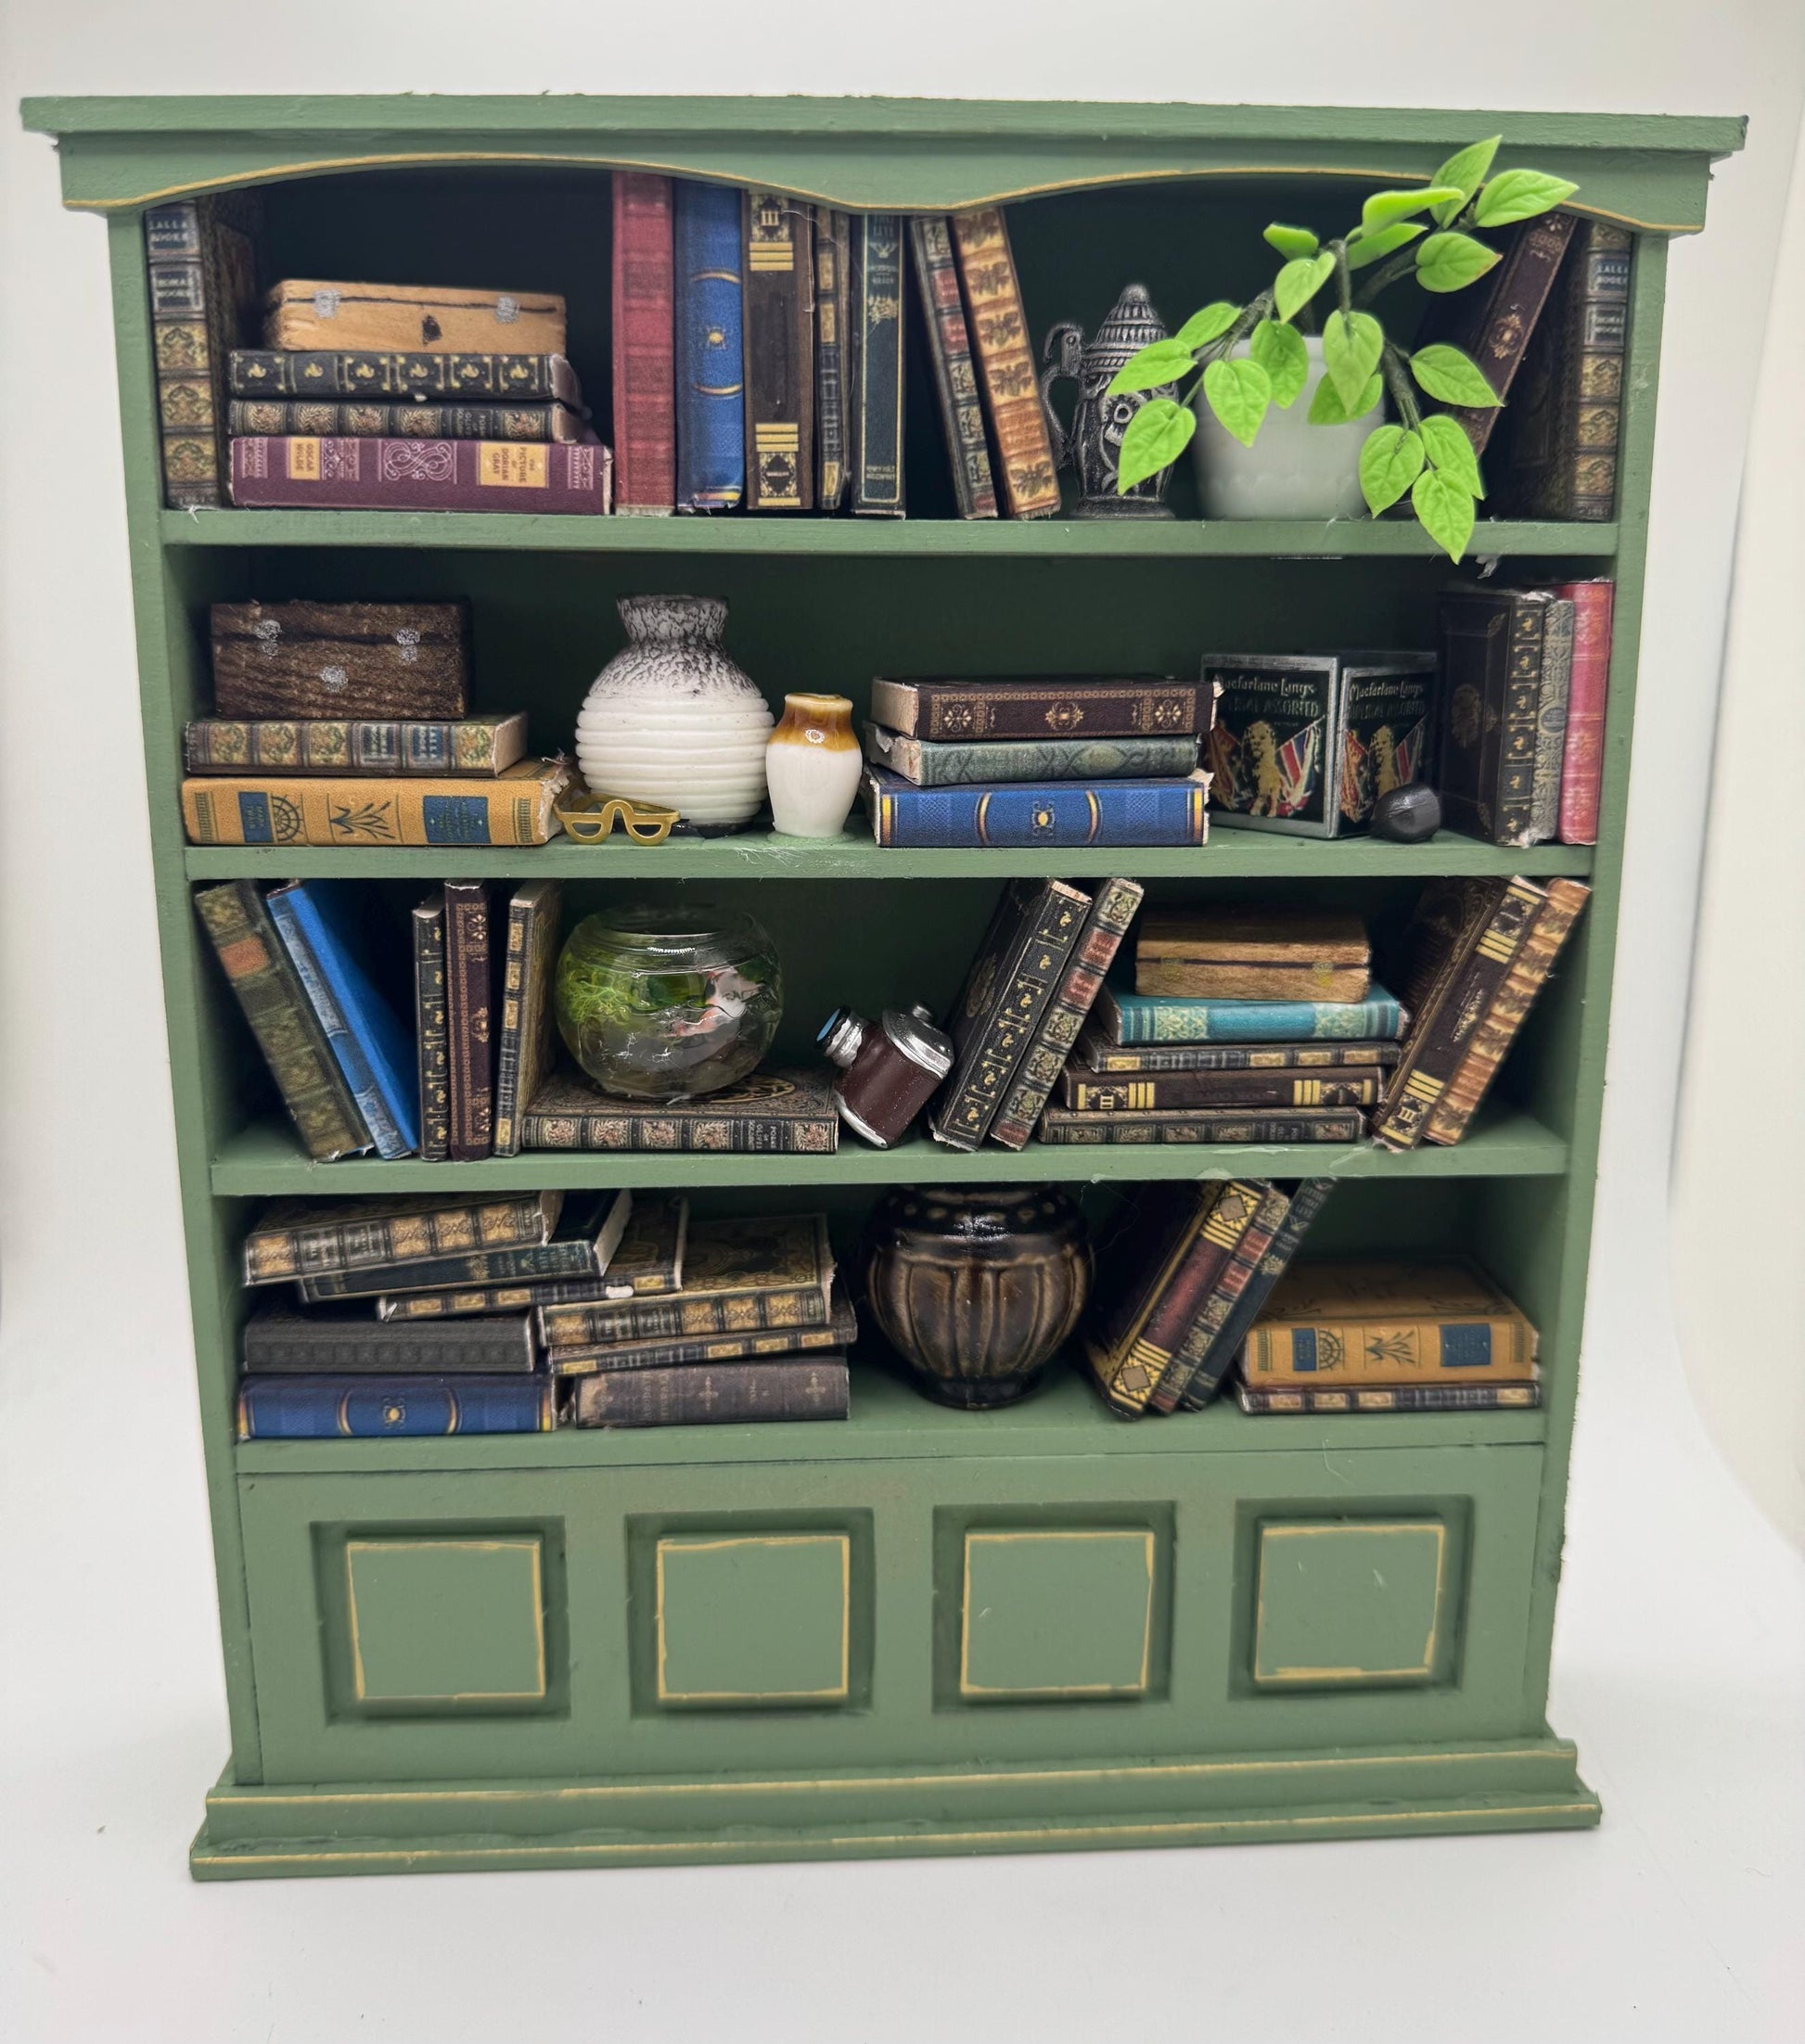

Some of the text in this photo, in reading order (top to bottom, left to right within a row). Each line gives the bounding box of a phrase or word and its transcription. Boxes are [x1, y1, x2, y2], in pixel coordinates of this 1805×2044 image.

[295, 442, 305, 471] WILDE
[305, 443, 314, 472] OSCAR
[492, 452, 501, 475] GRAY
[502, 447, 510, 481] DORIAN
[519, 446, 528, 483] PICTURE
